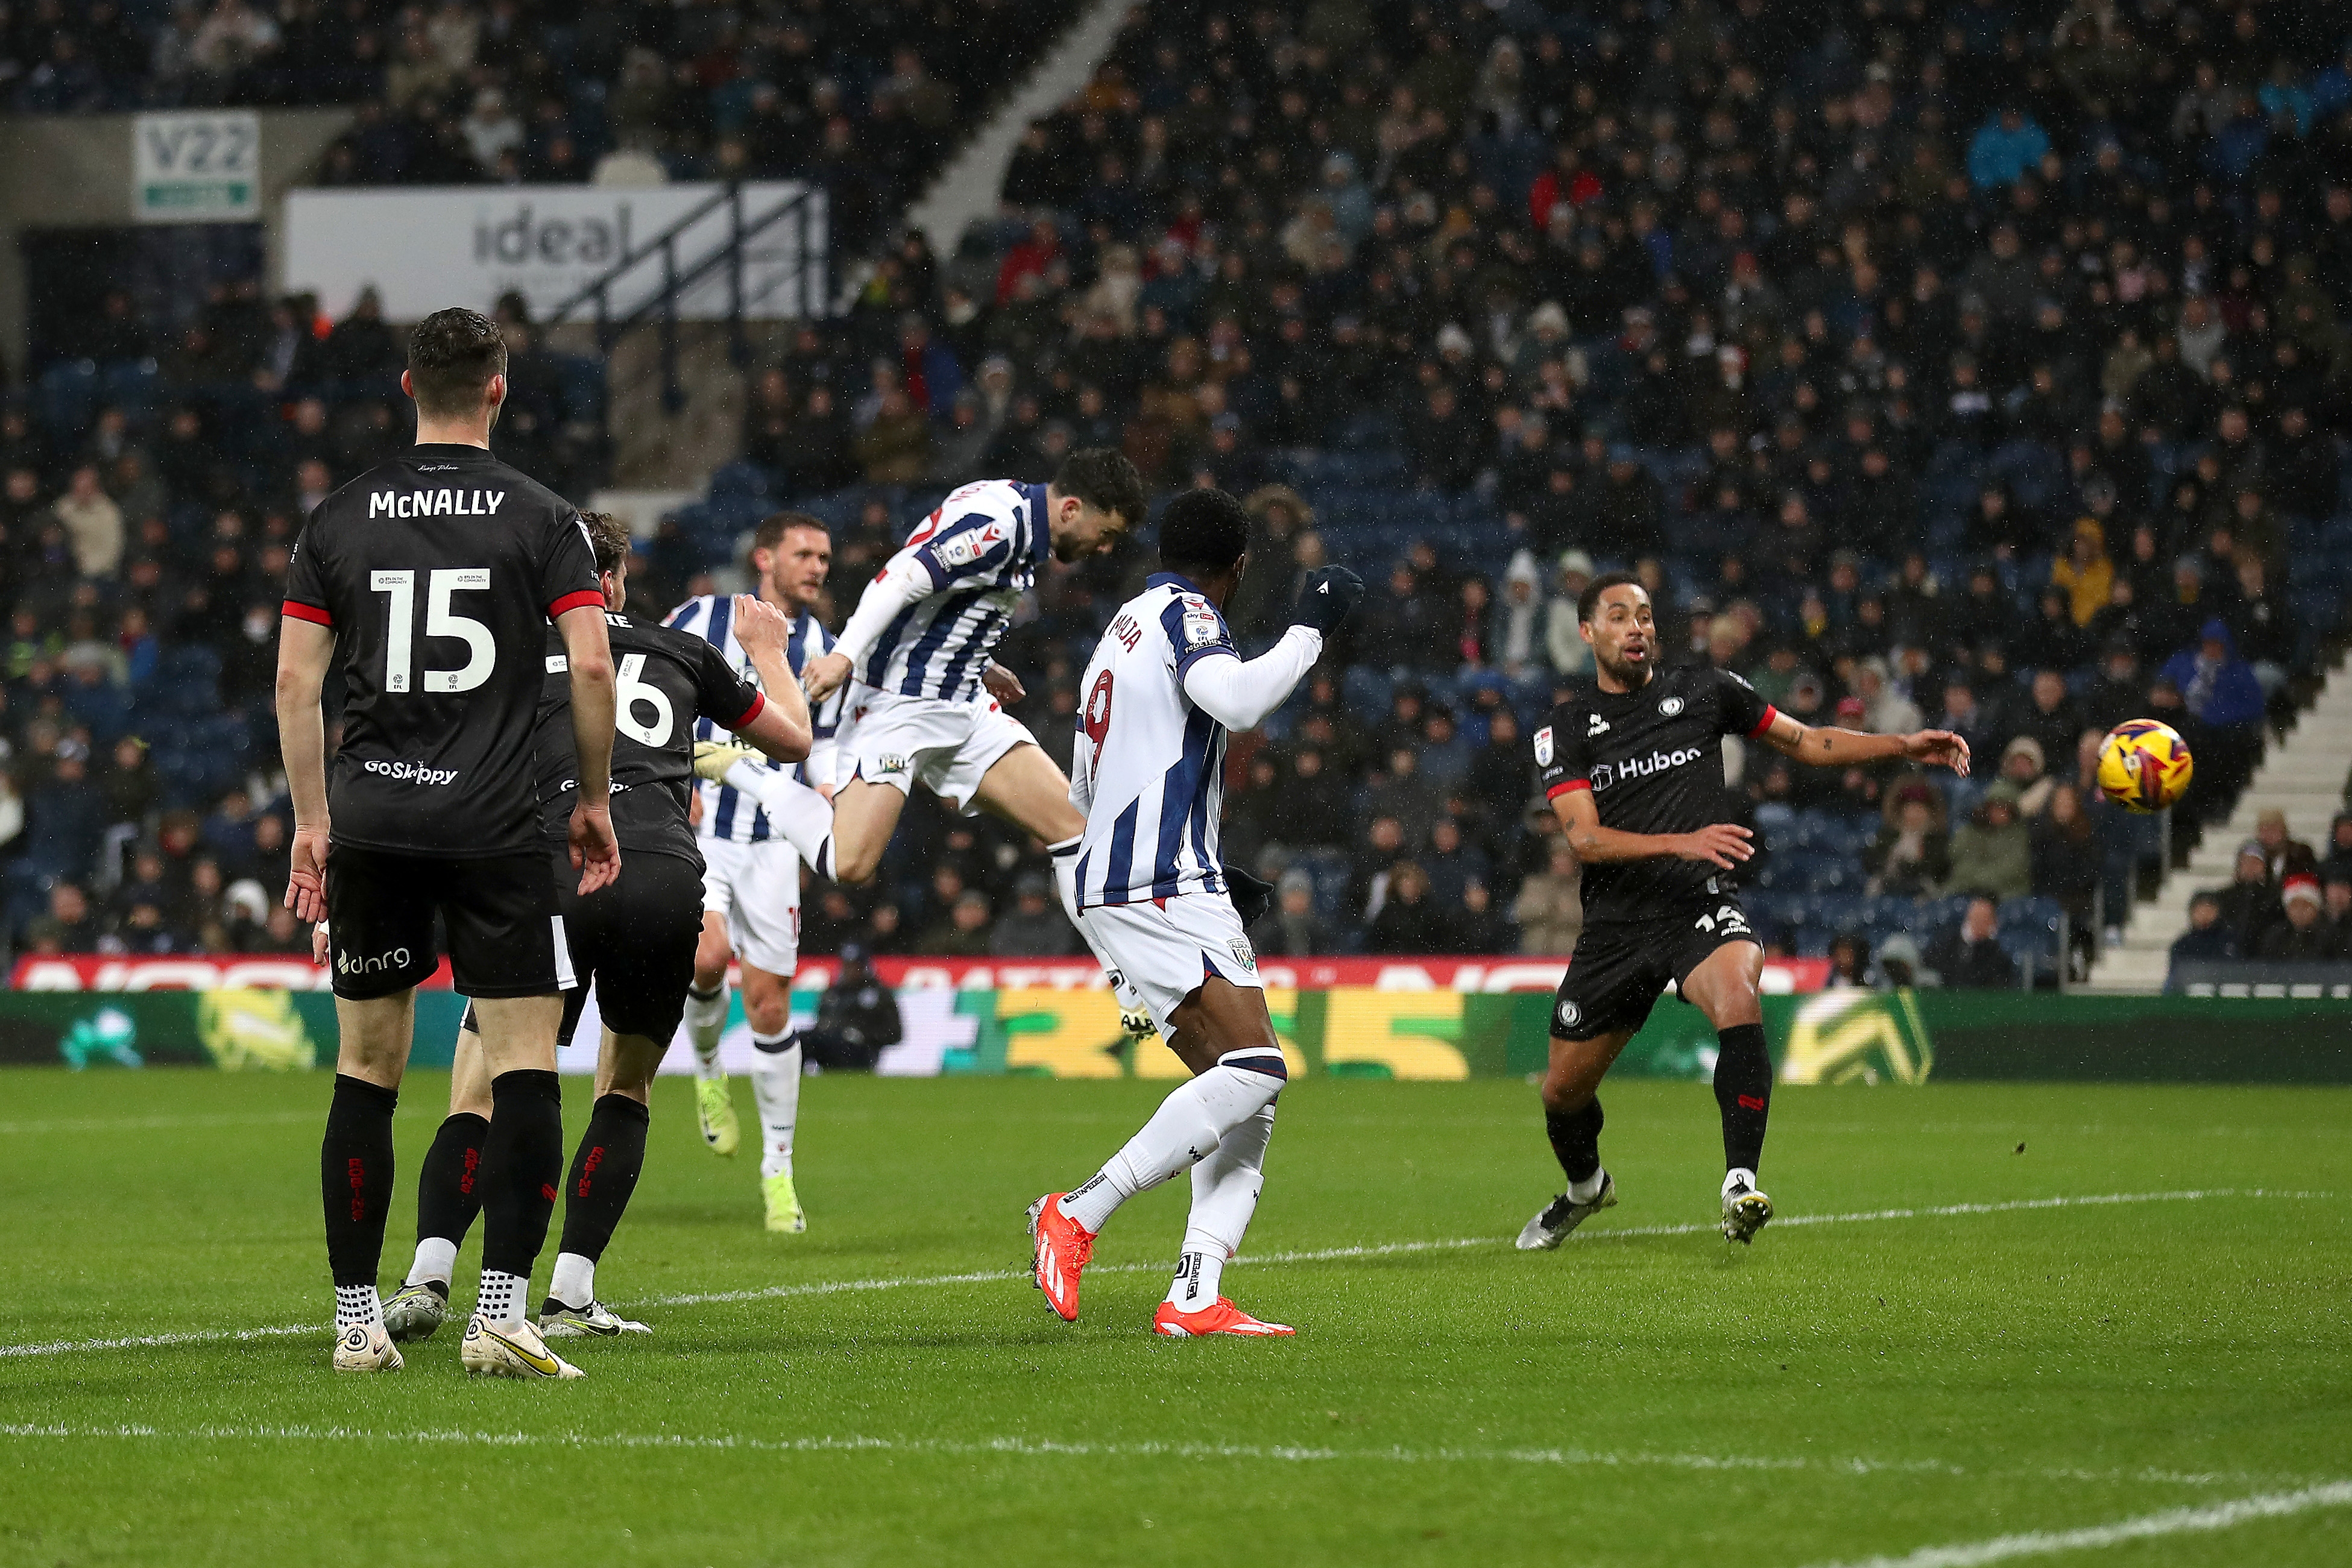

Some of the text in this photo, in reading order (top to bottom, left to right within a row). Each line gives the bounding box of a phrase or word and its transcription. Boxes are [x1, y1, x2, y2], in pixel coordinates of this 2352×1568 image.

[147, 122, 253, 171] V22
[474, 200, 633, 264] ideal
[368, 489, 505, 518] McNALLY
[370, 568, 496, 693] 15
[1086, 669, 1114, 782] 9
